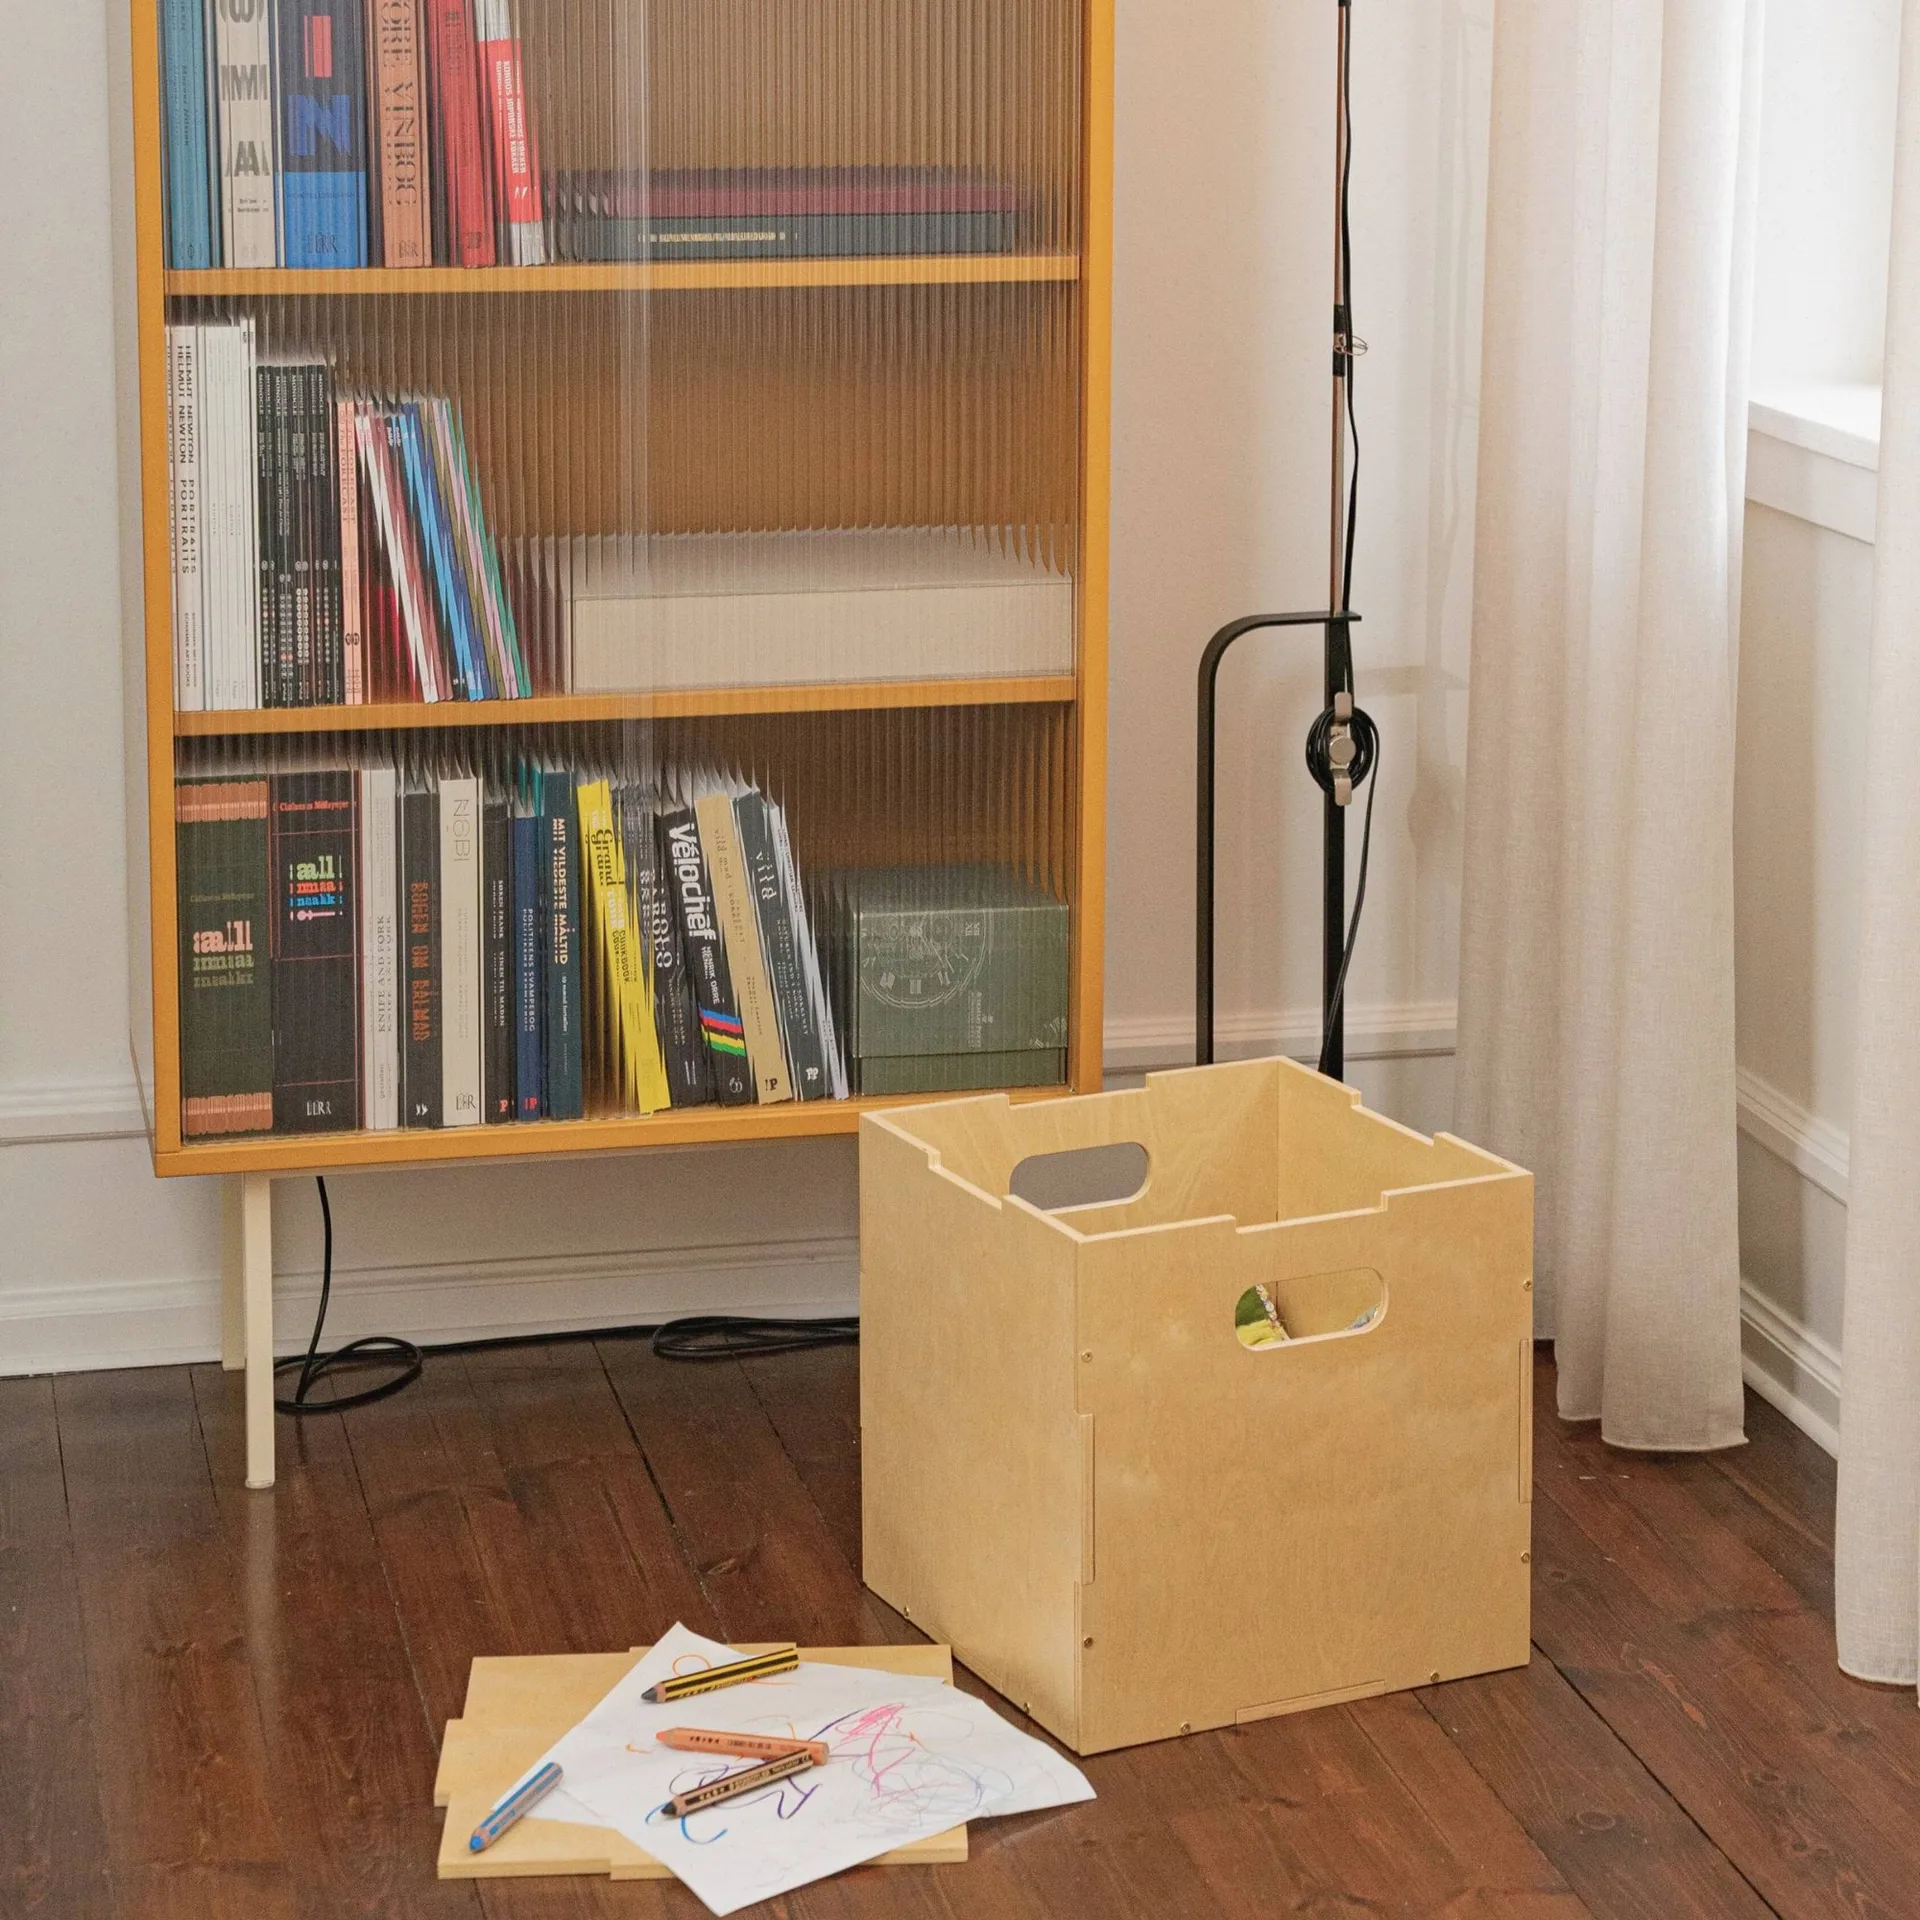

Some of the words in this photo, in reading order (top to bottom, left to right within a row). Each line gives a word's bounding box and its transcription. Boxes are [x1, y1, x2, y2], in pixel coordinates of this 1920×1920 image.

[553, 818, 565, 841] MIT
[553, 847, 566, 910] VILDESTE
[669, 823, 716, 941] Vélochef
[754, 850, 776, 900] vild
[523, 908, 534, 968] POLITIKENS
[554, 914, 575, 964] MÅLTID
[524, 971, 536, 1032] SVAMPEBOG
[701, 946, 715, 979] HENRIK
[709, 980, 721, 1004] ORRE
